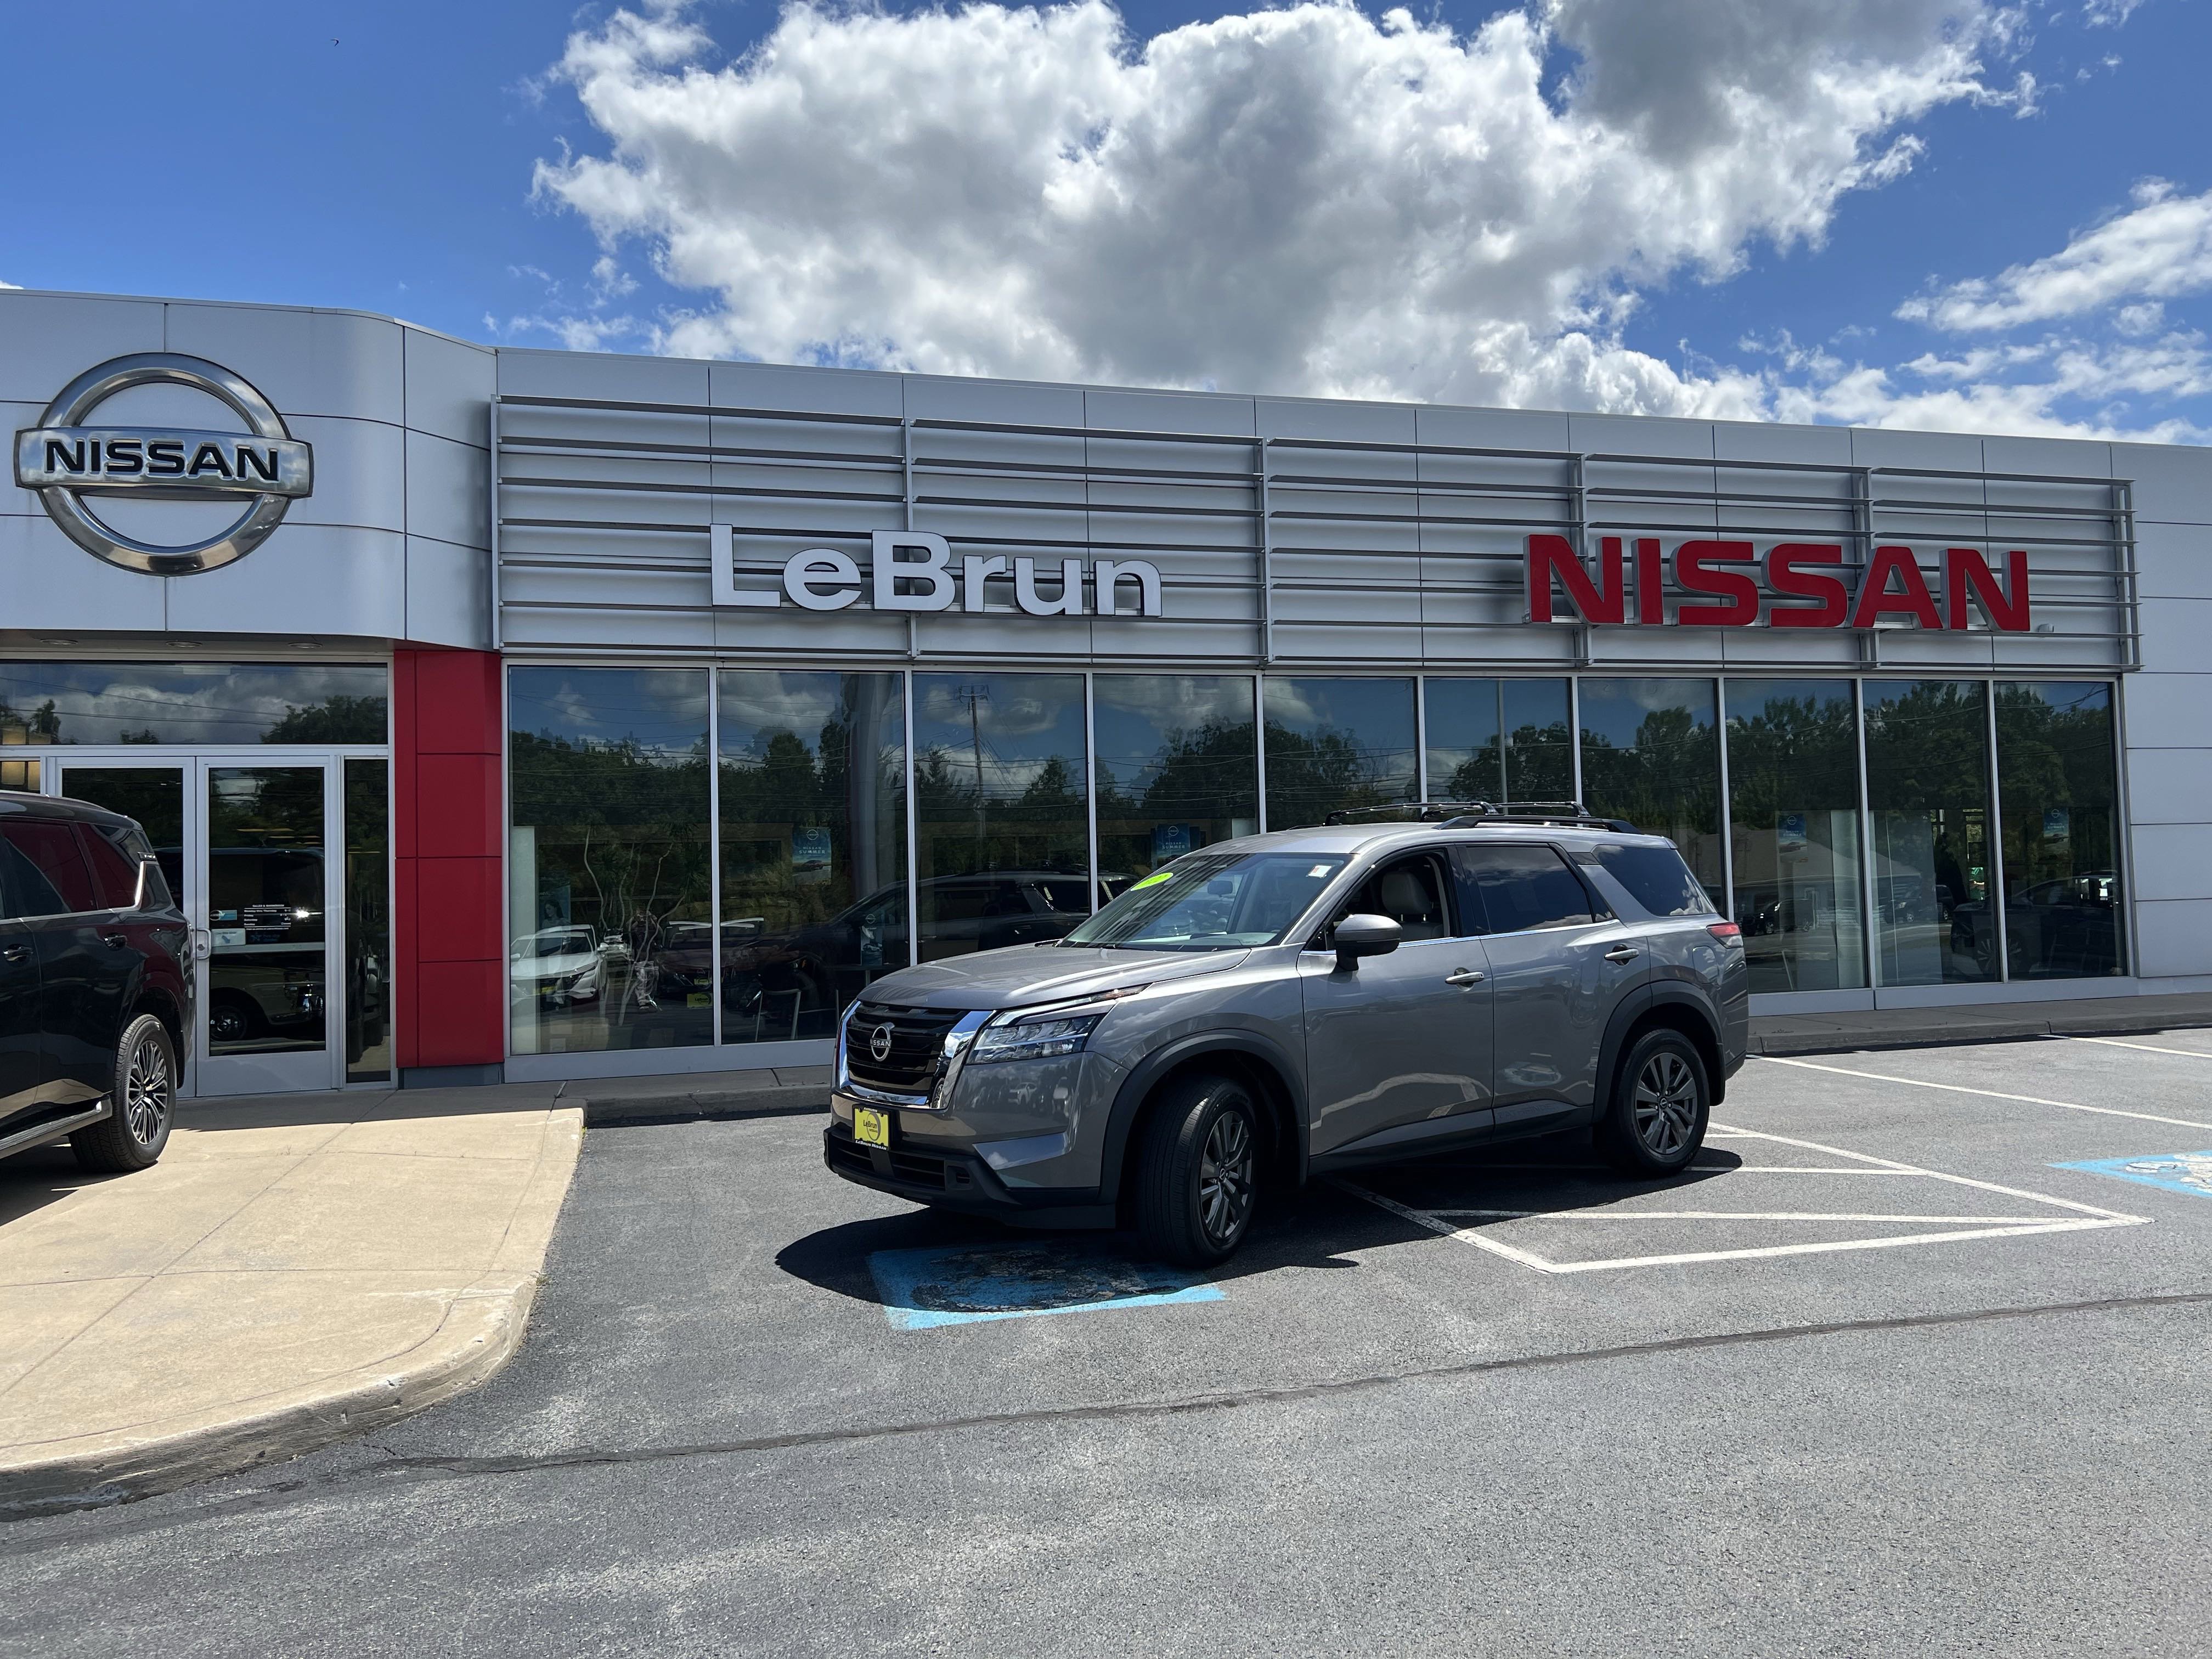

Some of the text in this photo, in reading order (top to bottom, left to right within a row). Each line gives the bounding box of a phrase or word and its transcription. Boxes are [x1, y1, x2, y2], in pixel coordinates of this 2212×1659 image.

[45, 438, 280, 482] NISSAN
[709, 523, 1163, 617] LeBrun
[1523, 534, 2030, 632] NISSAN
[864, 1120, 877, 1128] LeBrun
